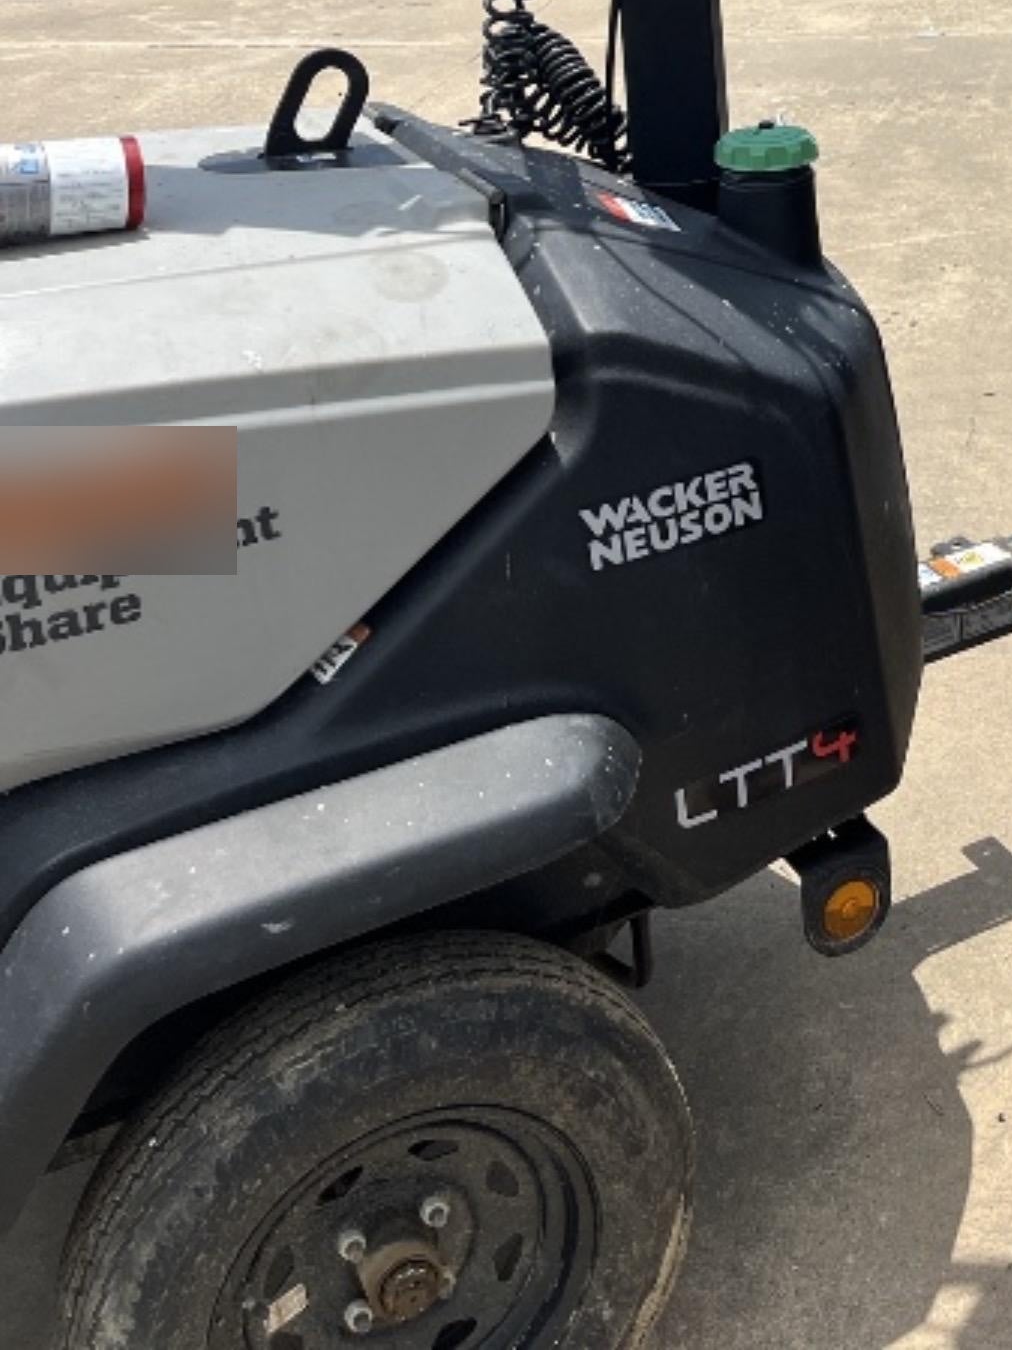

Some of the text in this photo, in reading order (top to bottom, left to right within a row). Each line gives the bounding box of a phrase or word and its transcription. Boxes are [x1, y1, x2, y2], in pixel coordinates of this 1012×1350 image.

[579, 461, 758, 536] WACKER
[587, 491, 763, 571] NEUSON
[0, 593, 142, 655] hare
